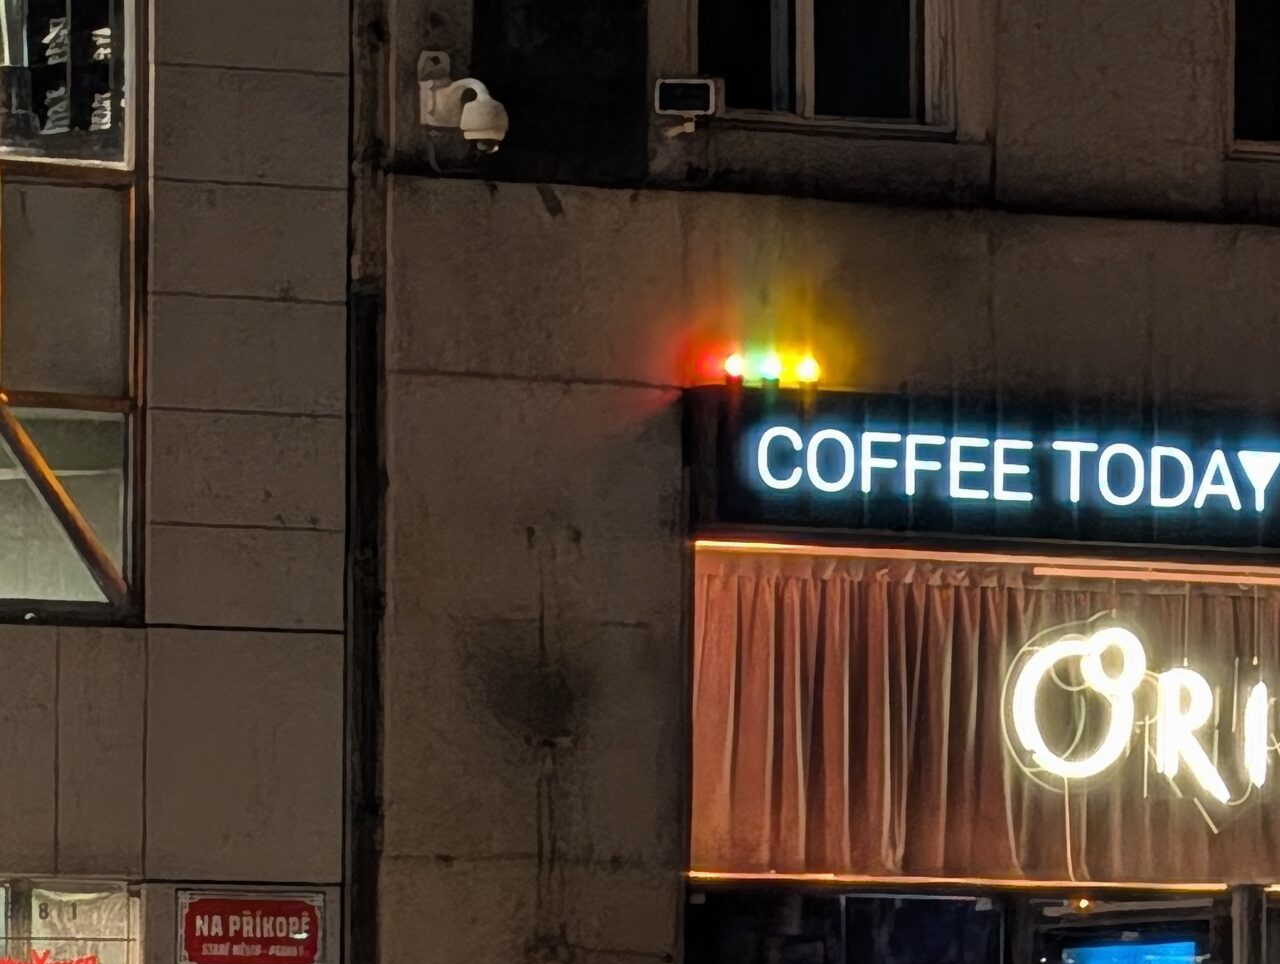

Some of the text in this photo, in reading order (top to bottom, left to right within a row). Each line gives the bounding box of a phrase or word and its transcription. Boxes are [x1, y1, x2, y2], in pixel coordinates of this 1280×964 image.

[757, 426, 1034, 502] COFFEE
[195, 909, 311, 939] NA PŘÍKOPĚ
